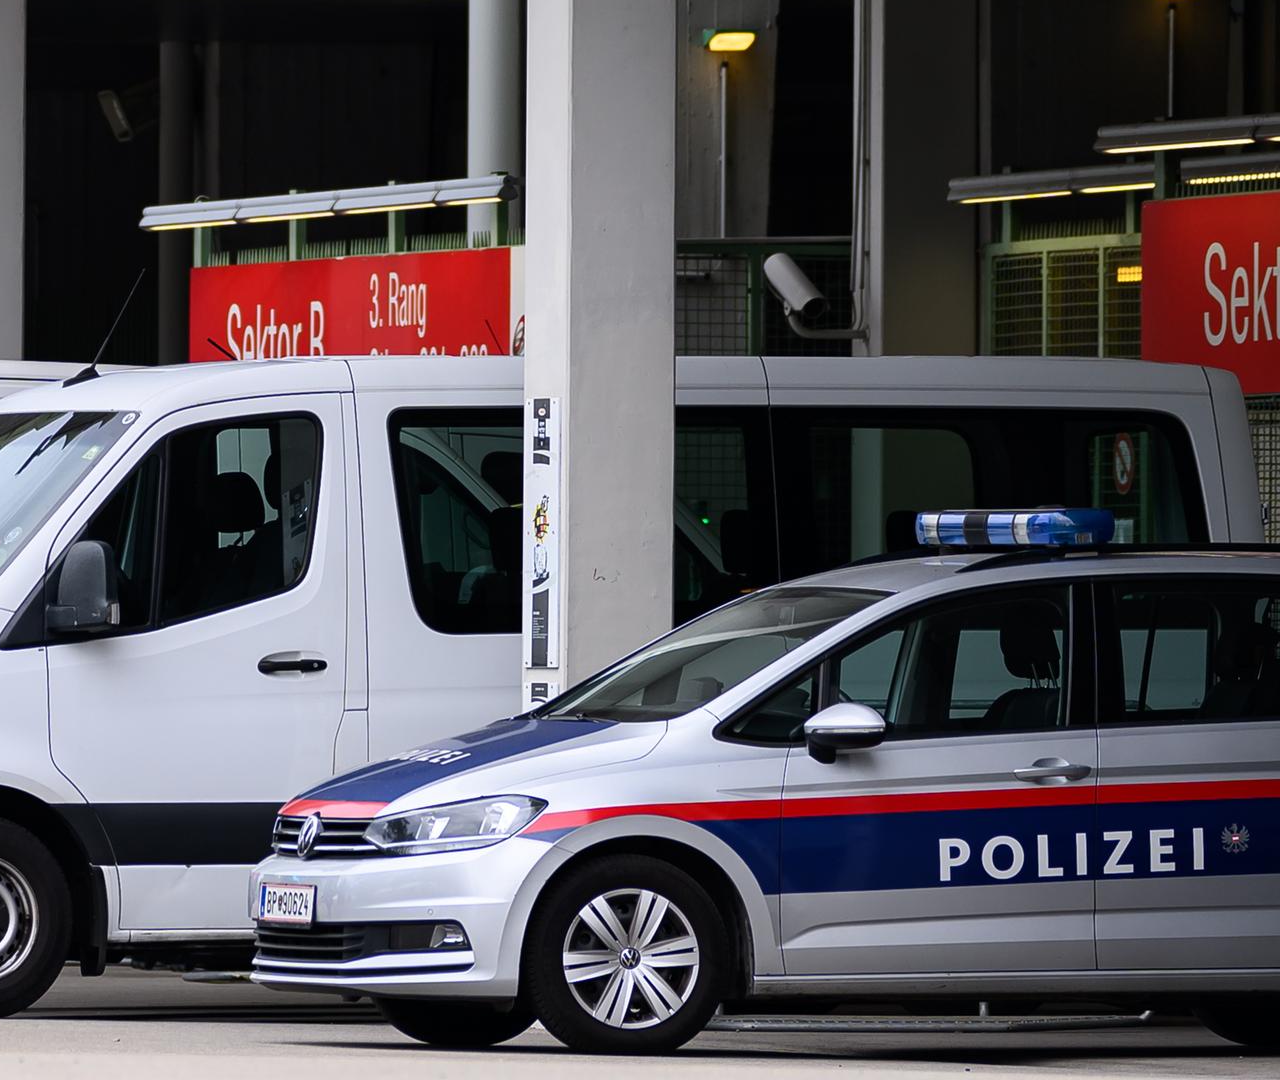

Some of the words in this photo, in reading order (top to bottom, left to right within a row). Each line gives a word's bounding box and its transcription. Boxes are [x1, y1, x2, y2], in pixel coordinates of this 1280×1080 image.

[227, 303, 302, 360] Sektor
[369, 273, 383, 328] 3.
[389, 272, 427, 338] Rang
[939, 827, 1204, 881] POLIZEI
